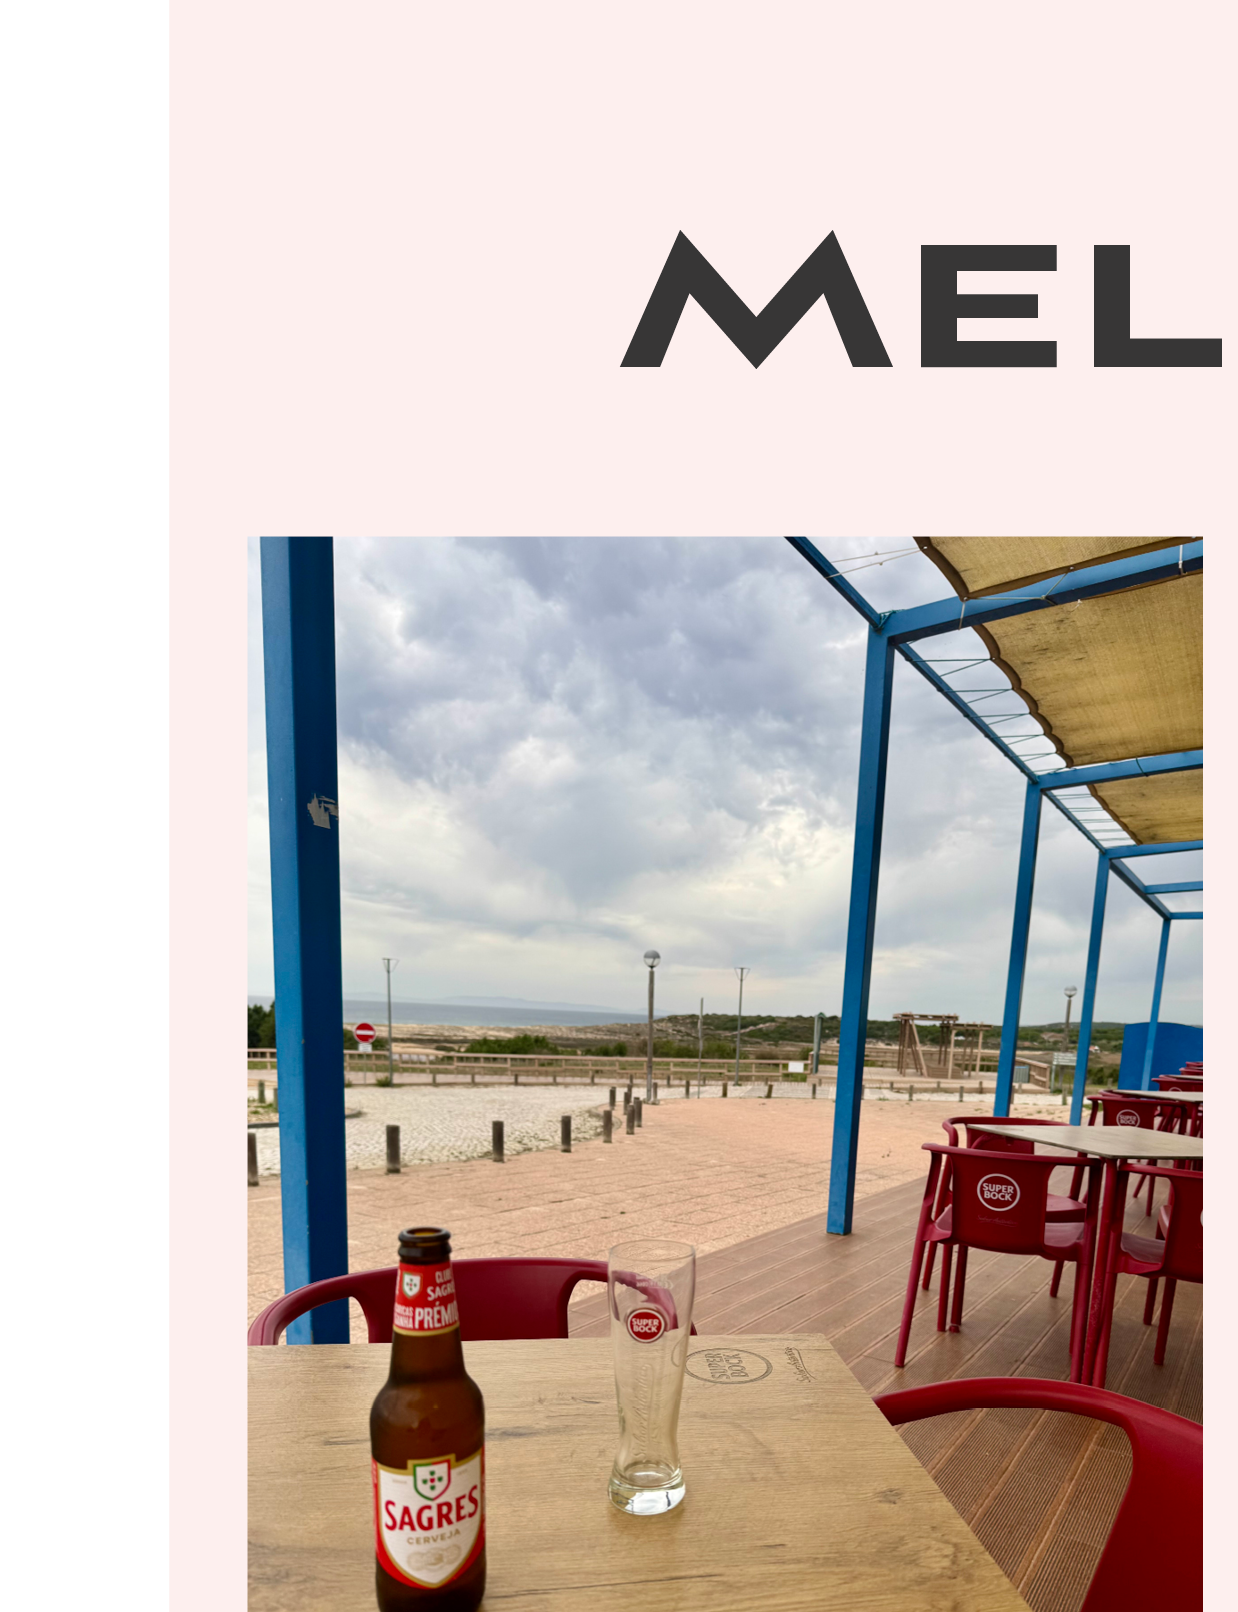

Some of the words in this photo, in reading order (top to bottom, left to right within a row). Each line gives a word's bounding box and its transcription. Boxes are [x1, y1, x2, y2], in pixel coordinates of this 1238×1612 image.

[982, 1182, 1014, 1194] SUPER
[984, 1190, 1012, 1201] BOCK
[632, 1317, 659, 1326] SUPER
[633, 1325, 658, 1333] BOCK
[704, 1353, 730, 1380] SUPER
[723, 1353, 749, 1378] BOCK
[385, 1484, 479, 1532] SAGRES
[407, 1528, 461, 1545] CERVEJA
